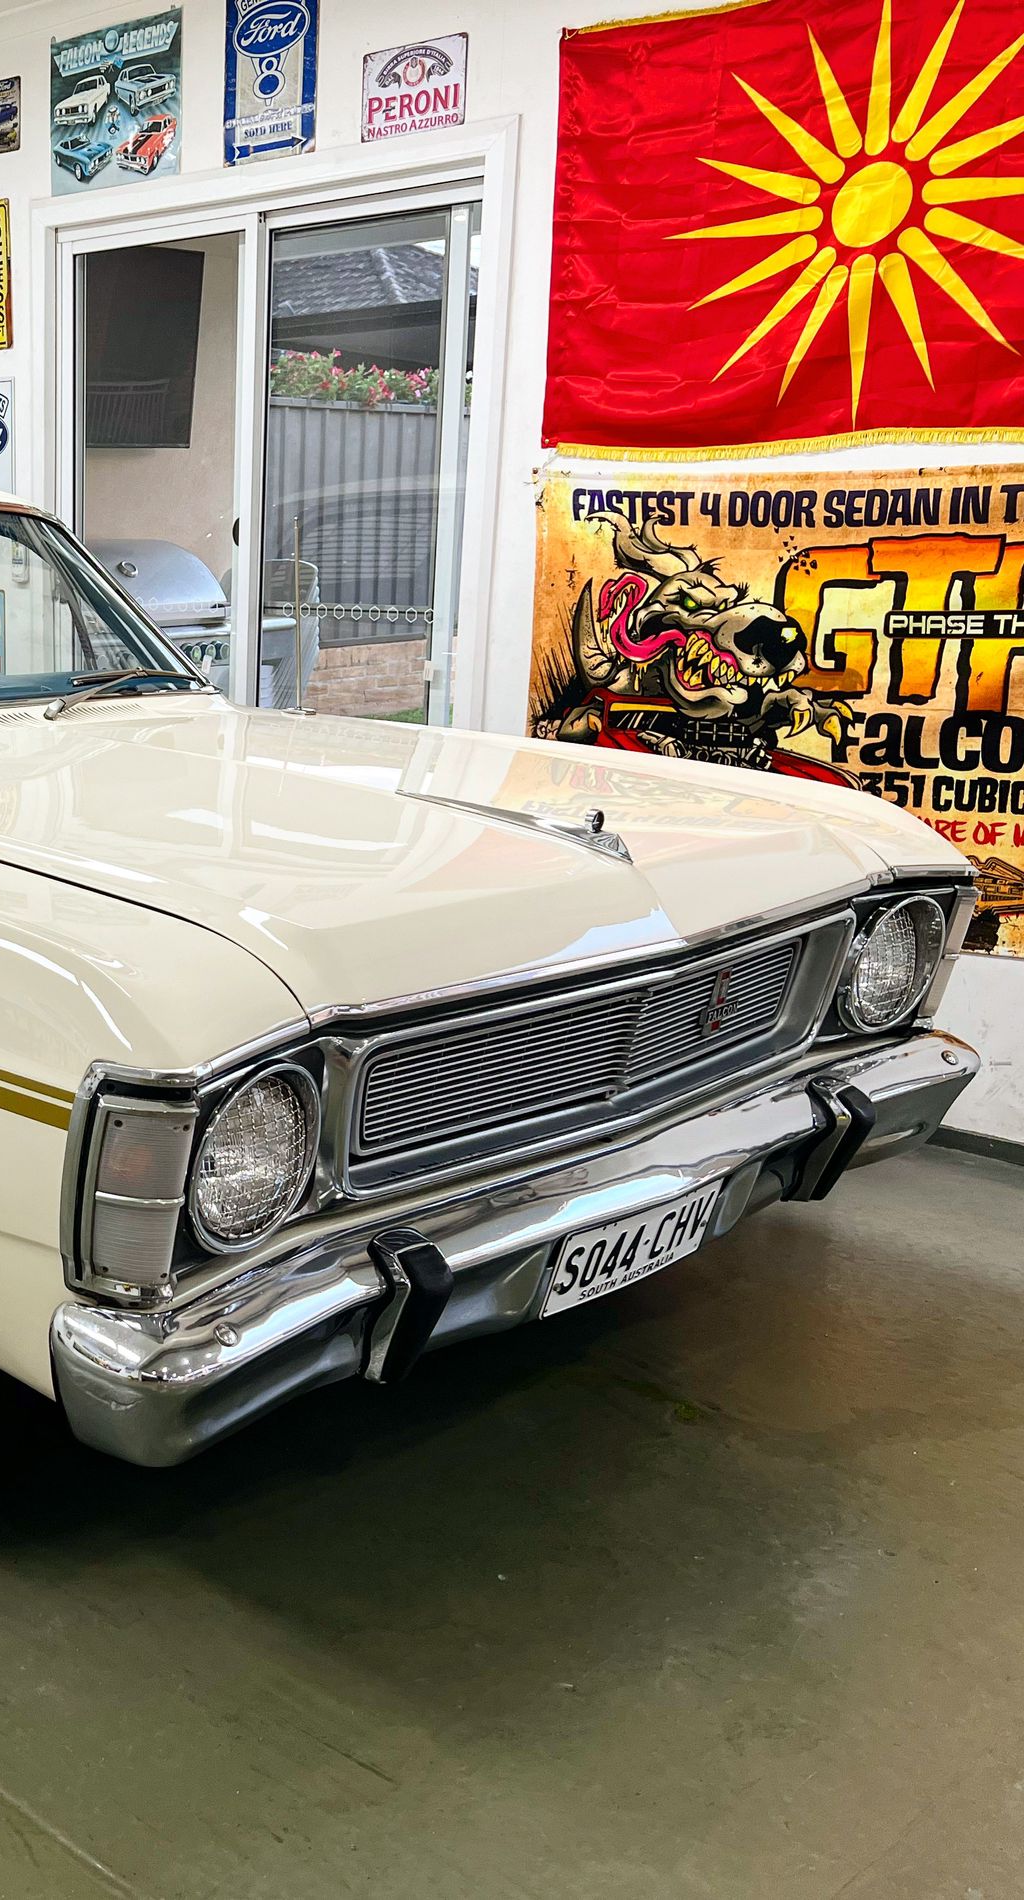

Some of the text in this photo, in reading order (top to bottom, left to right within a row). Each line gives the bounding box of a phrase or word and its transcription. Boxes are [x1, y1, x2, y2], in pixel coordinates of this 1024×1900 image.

[241, 11, 302, 46] Ford
[60, 21, 175, 71] FALCON LEGENDS
[367, 83, 460, 125] PERONI
[244, 120, 293, 138] SOLD HERE
[367, 112, 459, 139] NASTRO AZZURRO
[572, 488, 695, 526] FASTEST
[700, 492, 722, 527] 4
[727, 490, 818, 529] DOOR
[824, 487, 943, 528] SEDAN
[949, 485, 992, 525] IN
[889, 614, 985, 635] PHASE
[972, 820, 1007, 846] OF
[708, 1002, 738, 1023] FALCON
[578, 1253, 674, 1300] SOUTH AUSTRALIA
